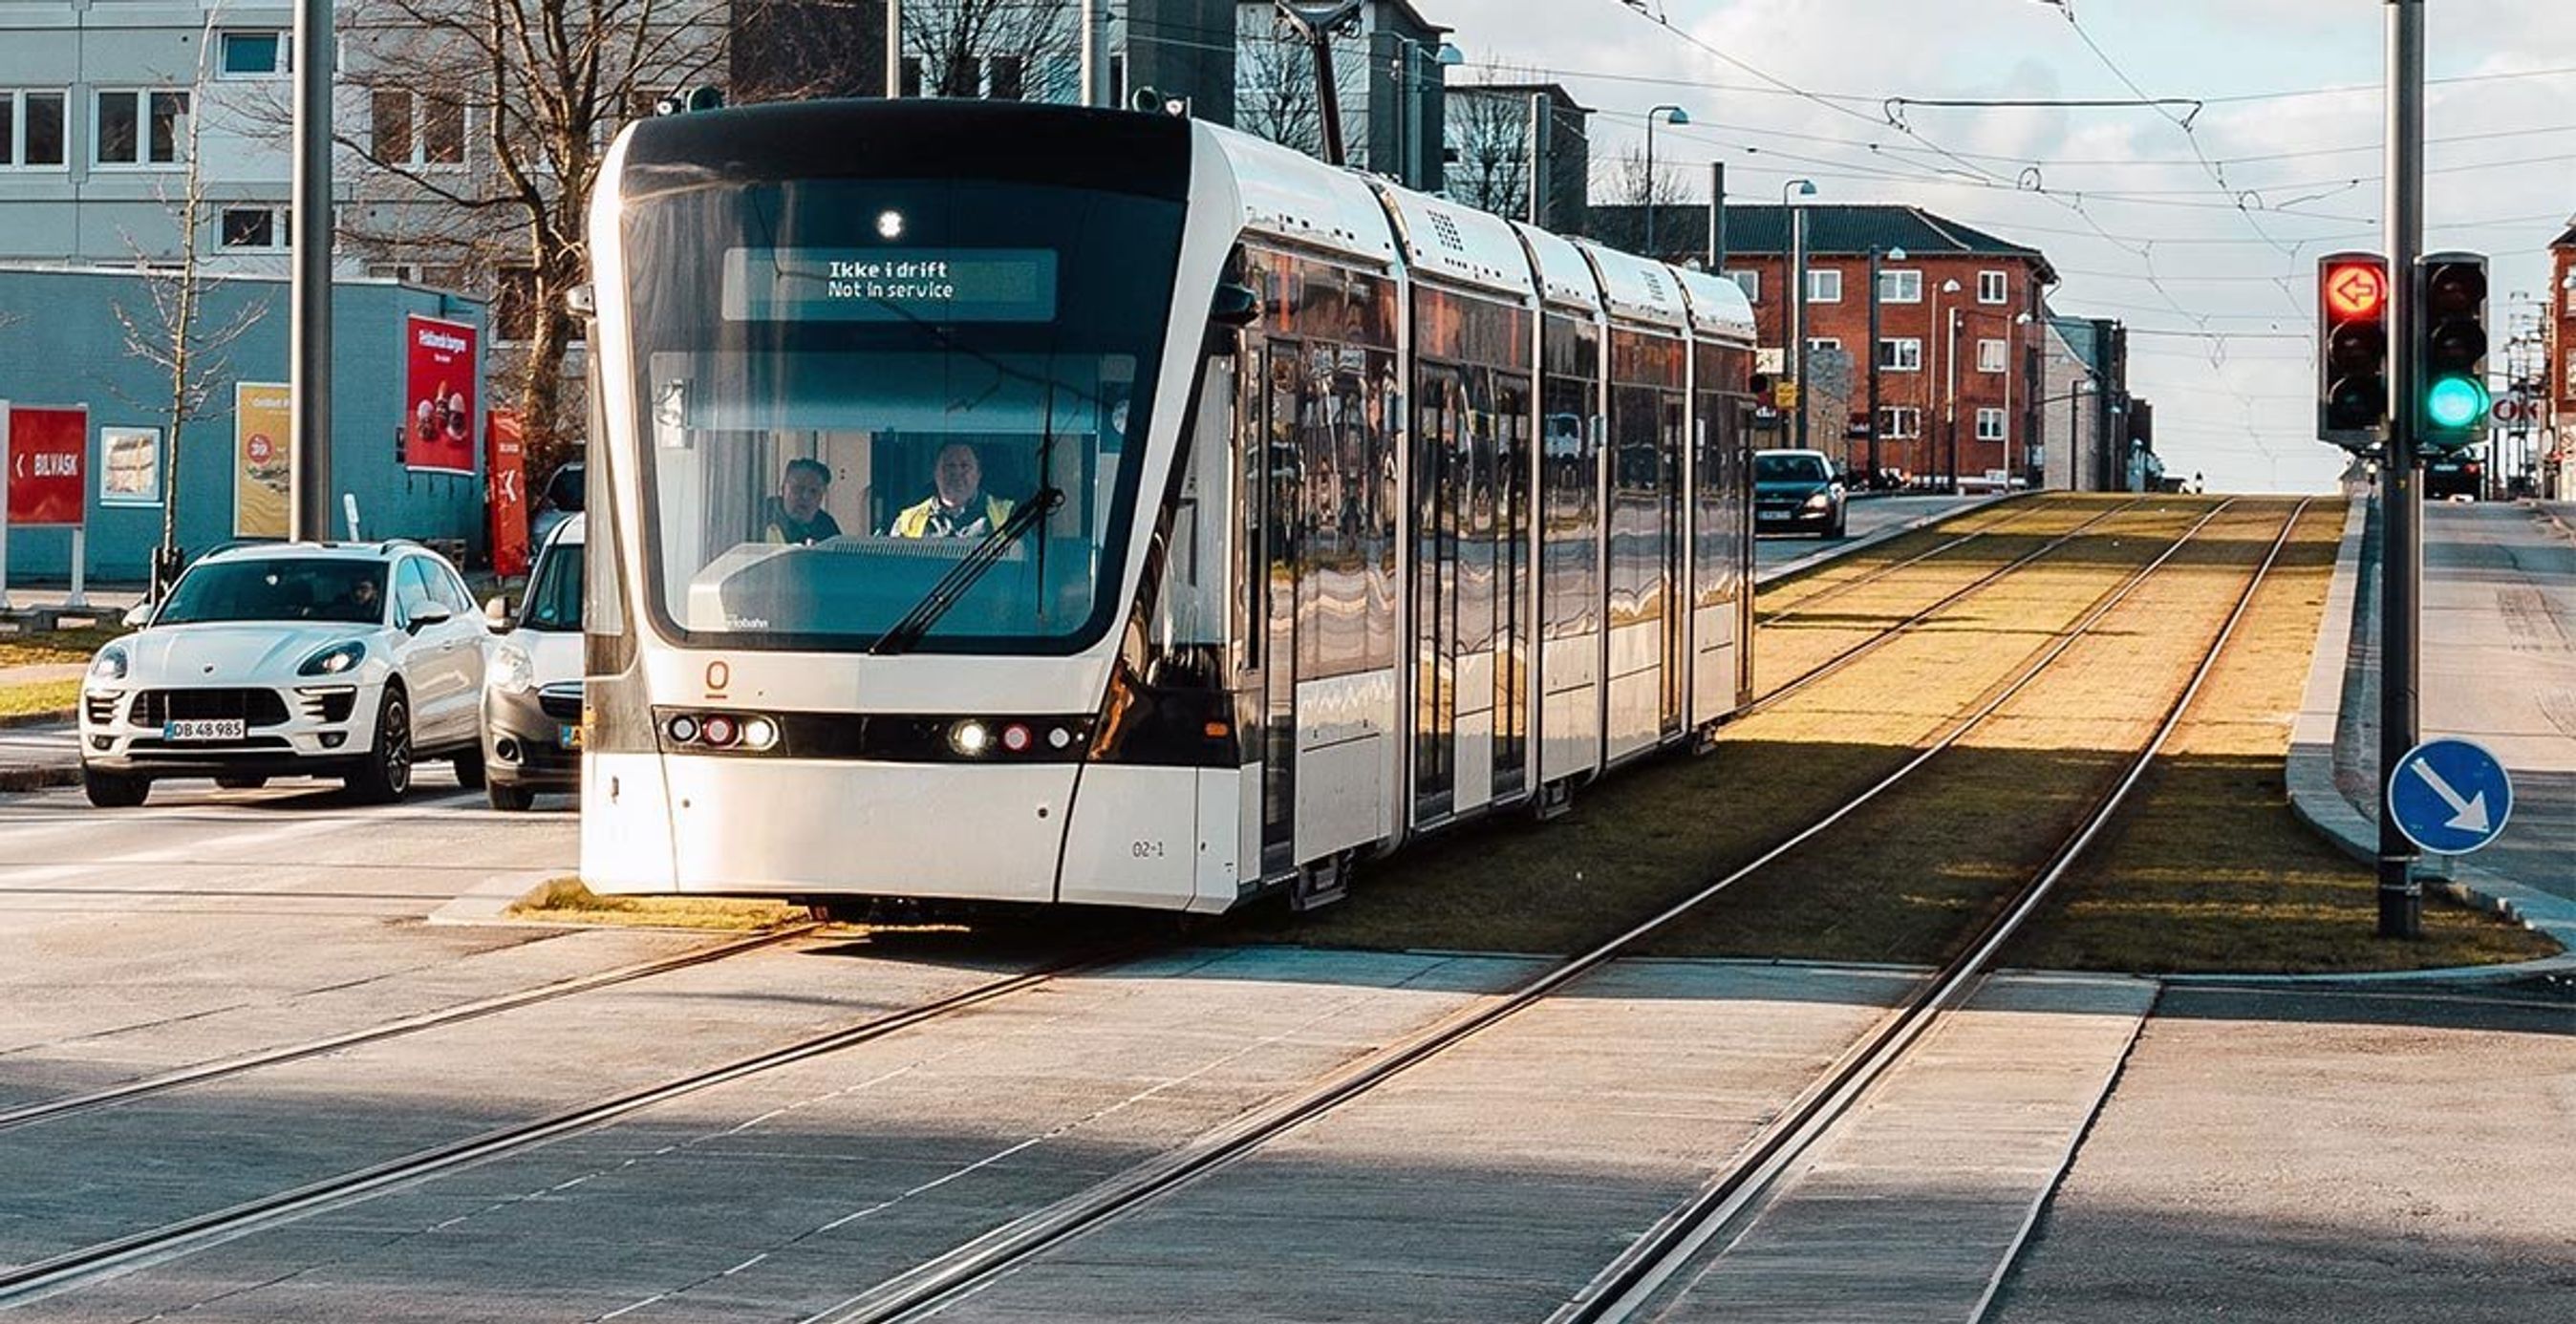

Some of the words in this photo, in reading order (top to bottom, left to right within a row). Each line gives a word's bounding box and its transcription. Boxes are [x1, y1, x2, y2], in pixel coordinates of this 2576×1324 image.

[828, 261, 880, 278] Ikke
[885, 261, 893, 278] i
[896, 261, 948, 278] drift
[827, 281, 862, 298] Not
[866, 281, 883, 298] in
[887, 281, 953, 298] service
[34, 453, 78, 477] BILVASK
[174, 723, 193, 737] DB
[196, 723, 213, 737] 48
[215, 722, 242, 736] 985
[1132, 841, 1164, 858] 02-1
